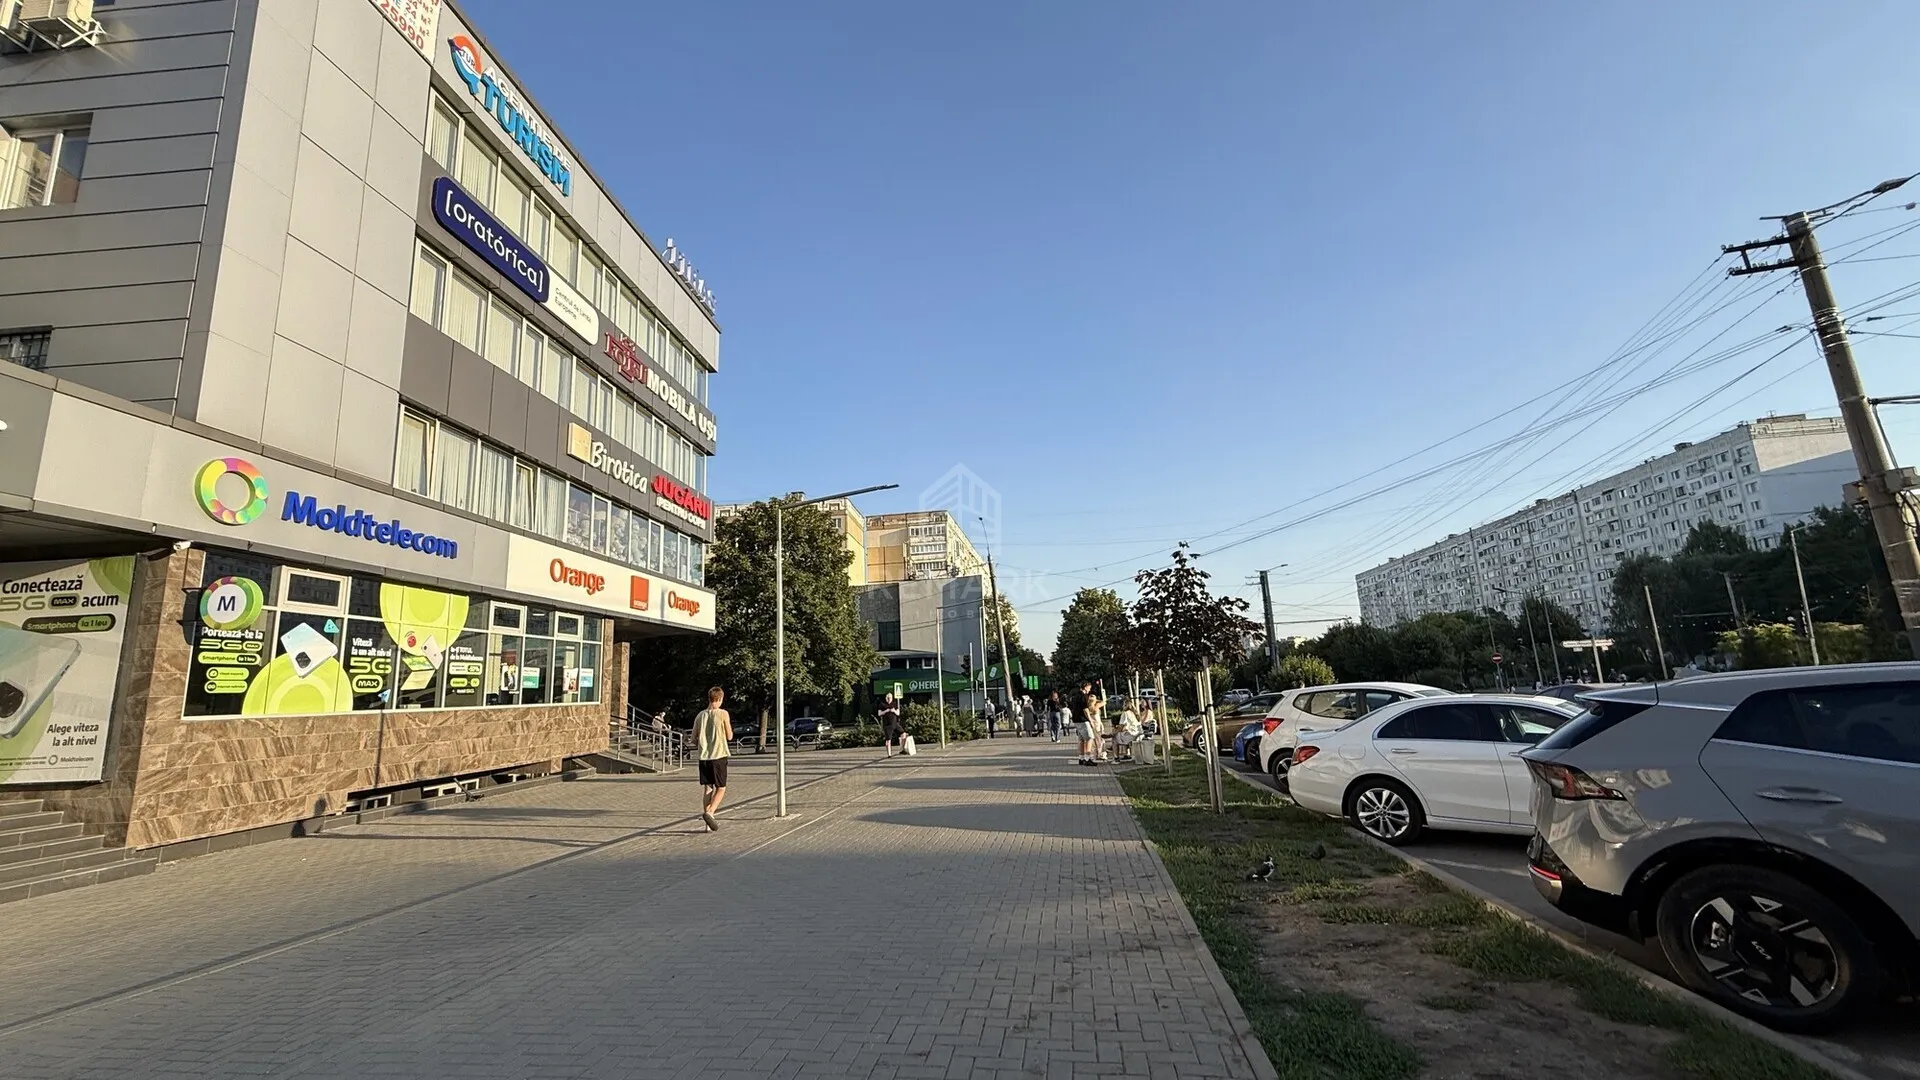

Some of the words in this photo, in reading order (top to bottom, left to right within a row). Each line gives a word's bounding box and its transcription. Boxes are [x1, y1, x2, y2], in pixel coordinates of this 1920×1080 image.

[480, 72, 571, 198] TURISM
[591, 440, 648, 494] Birotica
[280, 490, 459, 560] Moldtelecom
[2, 574, 84, 595] Conectează
[550, 557, 605, 595] Orange
[0, 595, 46, 612] 5G
[81, 594, 120, 608] acum
[217, 595, 237, 612] M
[667, 590, 701, 617] Orange
[27, 620, 77, 632] Smartphone
[81, 619, 89, 628] la
[95, 618, 108, 627] leu
[255, 629, 263, 640] la
[199, 638, 242, 650] 5G
[202, 655, 236, 663] Smartphone
[349, 656, 392, 674] 5G
[46, 723, 72, 736] Alege
[73, 722, 100, 733] viteza
[52, 736, 61, 747] la
[62, 736, 75, 747] alt
[75, 735, 98, 746] nivel
